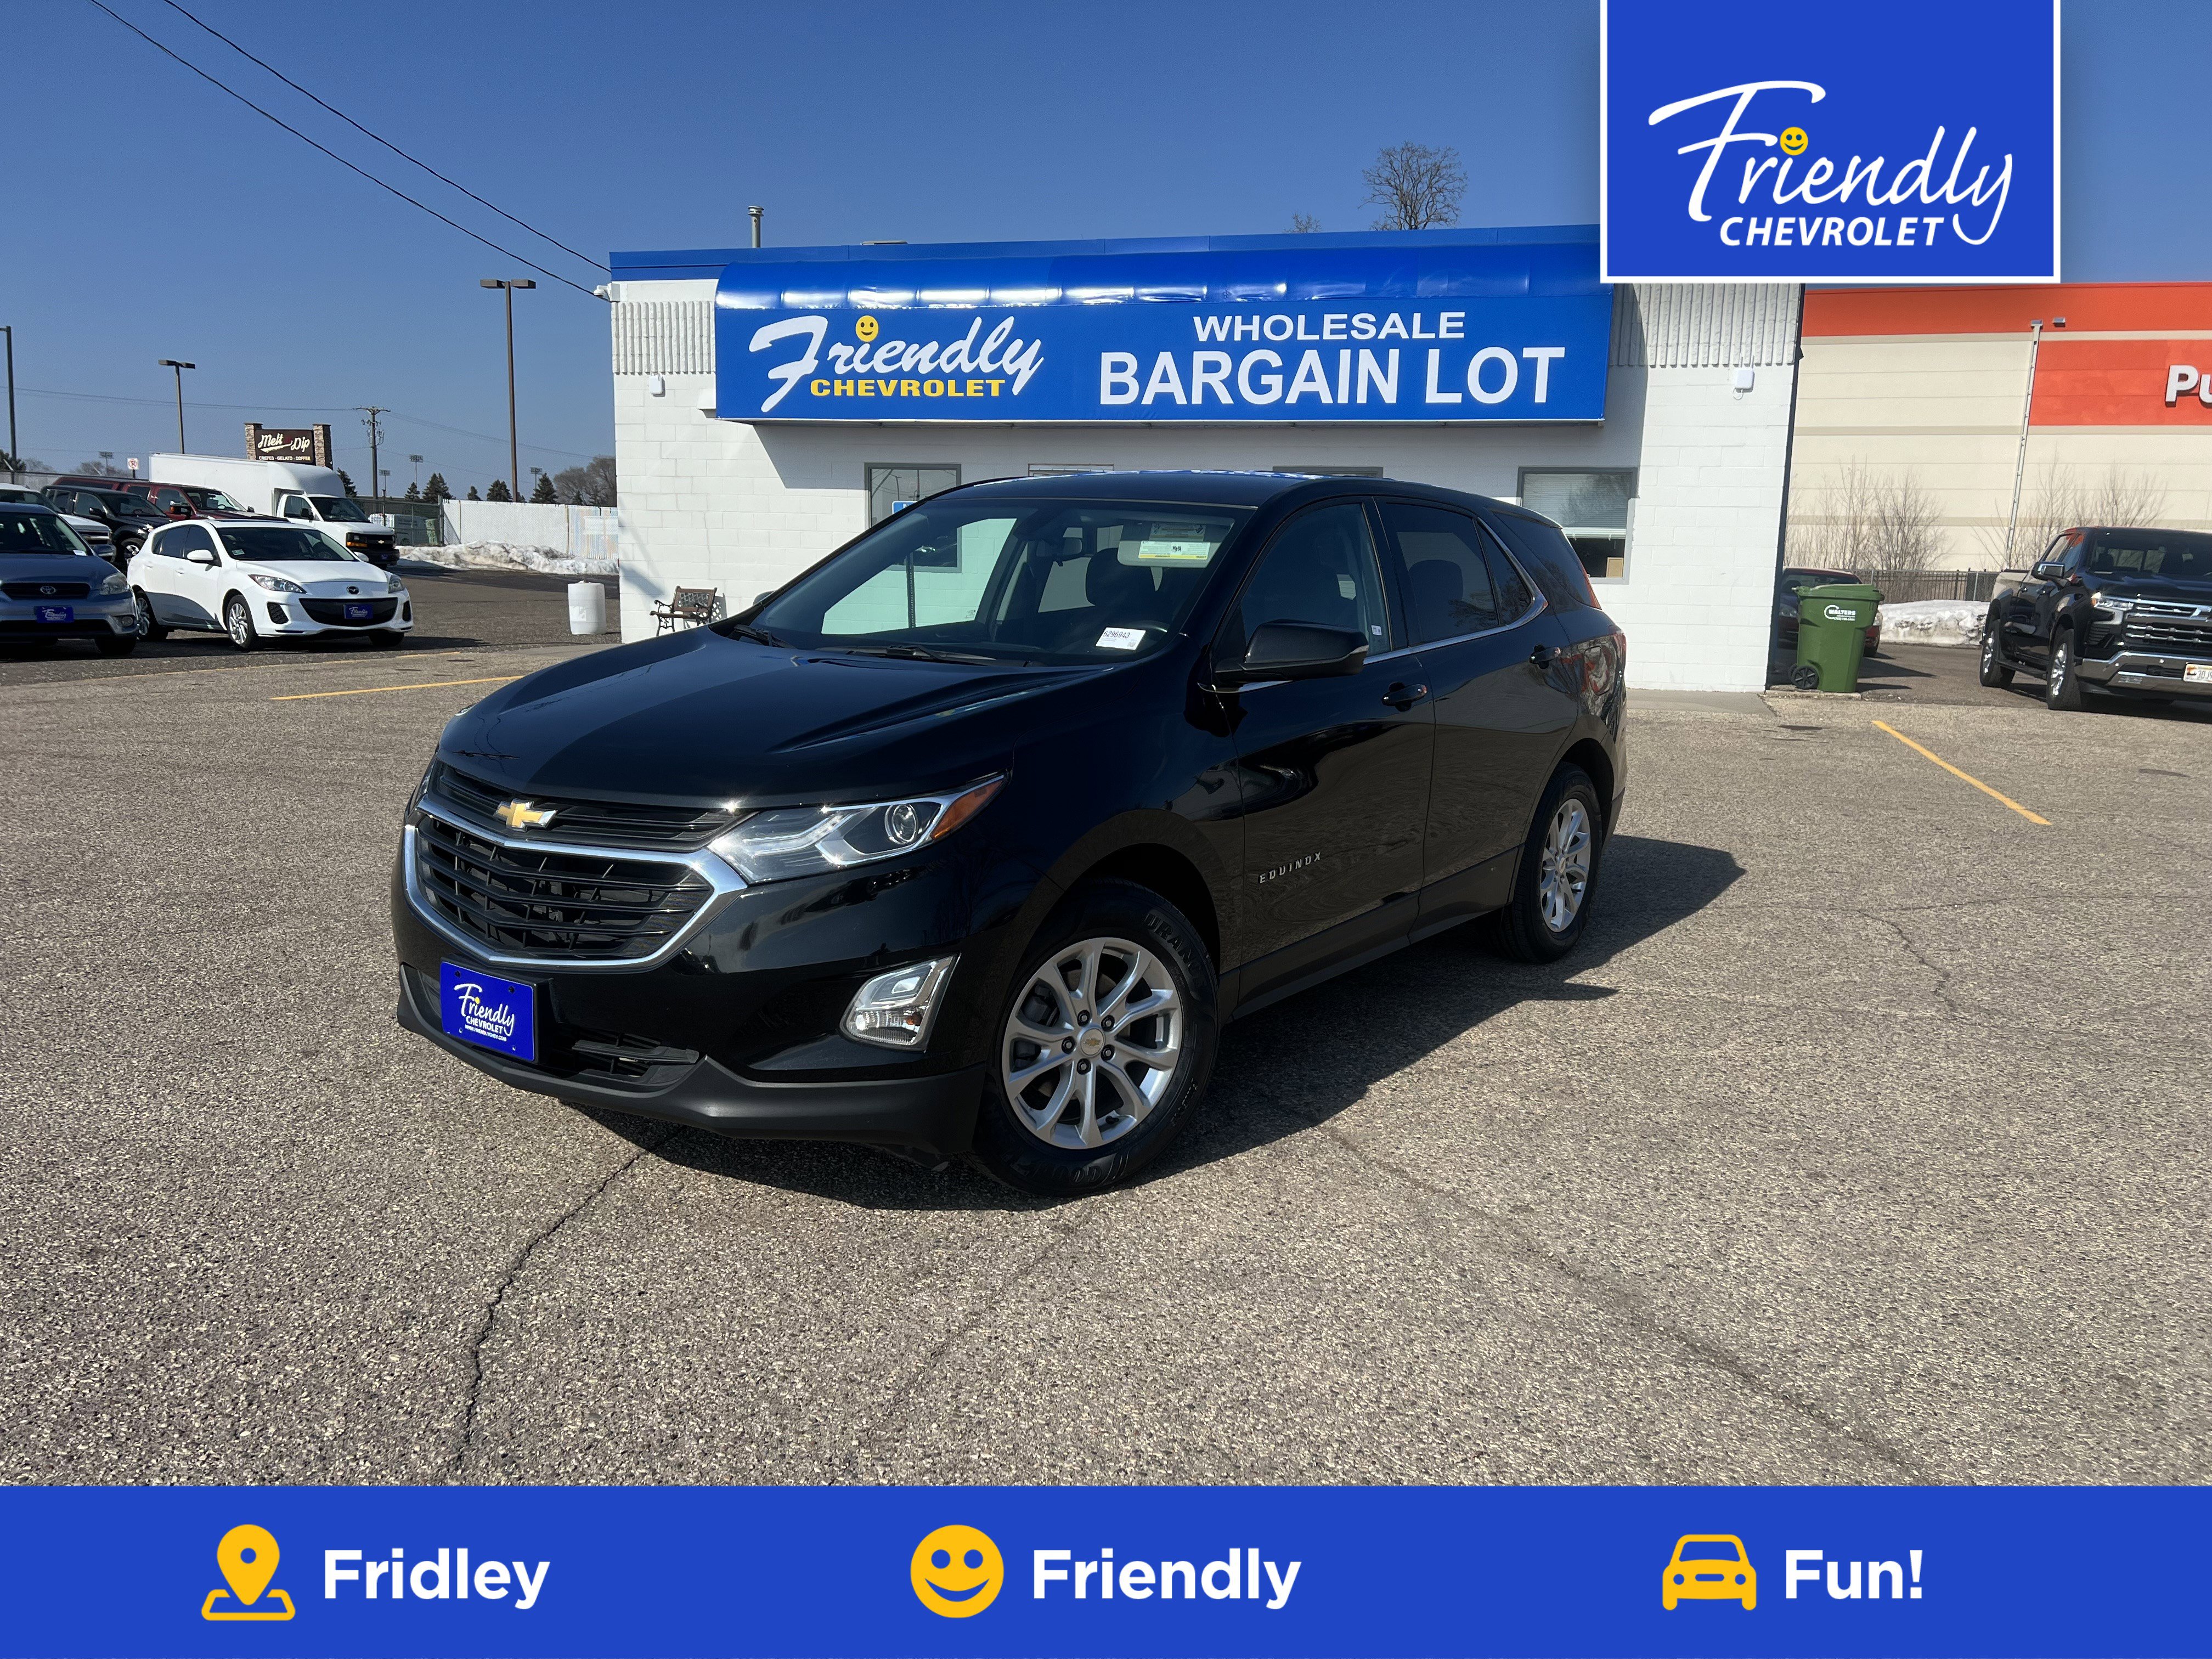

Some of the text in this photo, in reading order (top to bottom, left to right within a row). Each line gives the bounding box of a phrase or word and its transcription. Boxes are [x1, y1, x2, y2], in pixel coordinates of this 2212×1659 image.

[1193, 312, 1465, 342] WHOLESALE
[749, 315, 1044, 412] Friendly
[1100, 346, 1565, 405] BARGAIN LOT
[810, 379, 1005, 397] CHEVROLET
[257, 433, 311, 453] Melt Dip
[1259, 851, 1321, 884] EQUINOX
[454, 983, 515, 1036] Friendly
[466, 1015, 504, 1034] CHEVROLET
